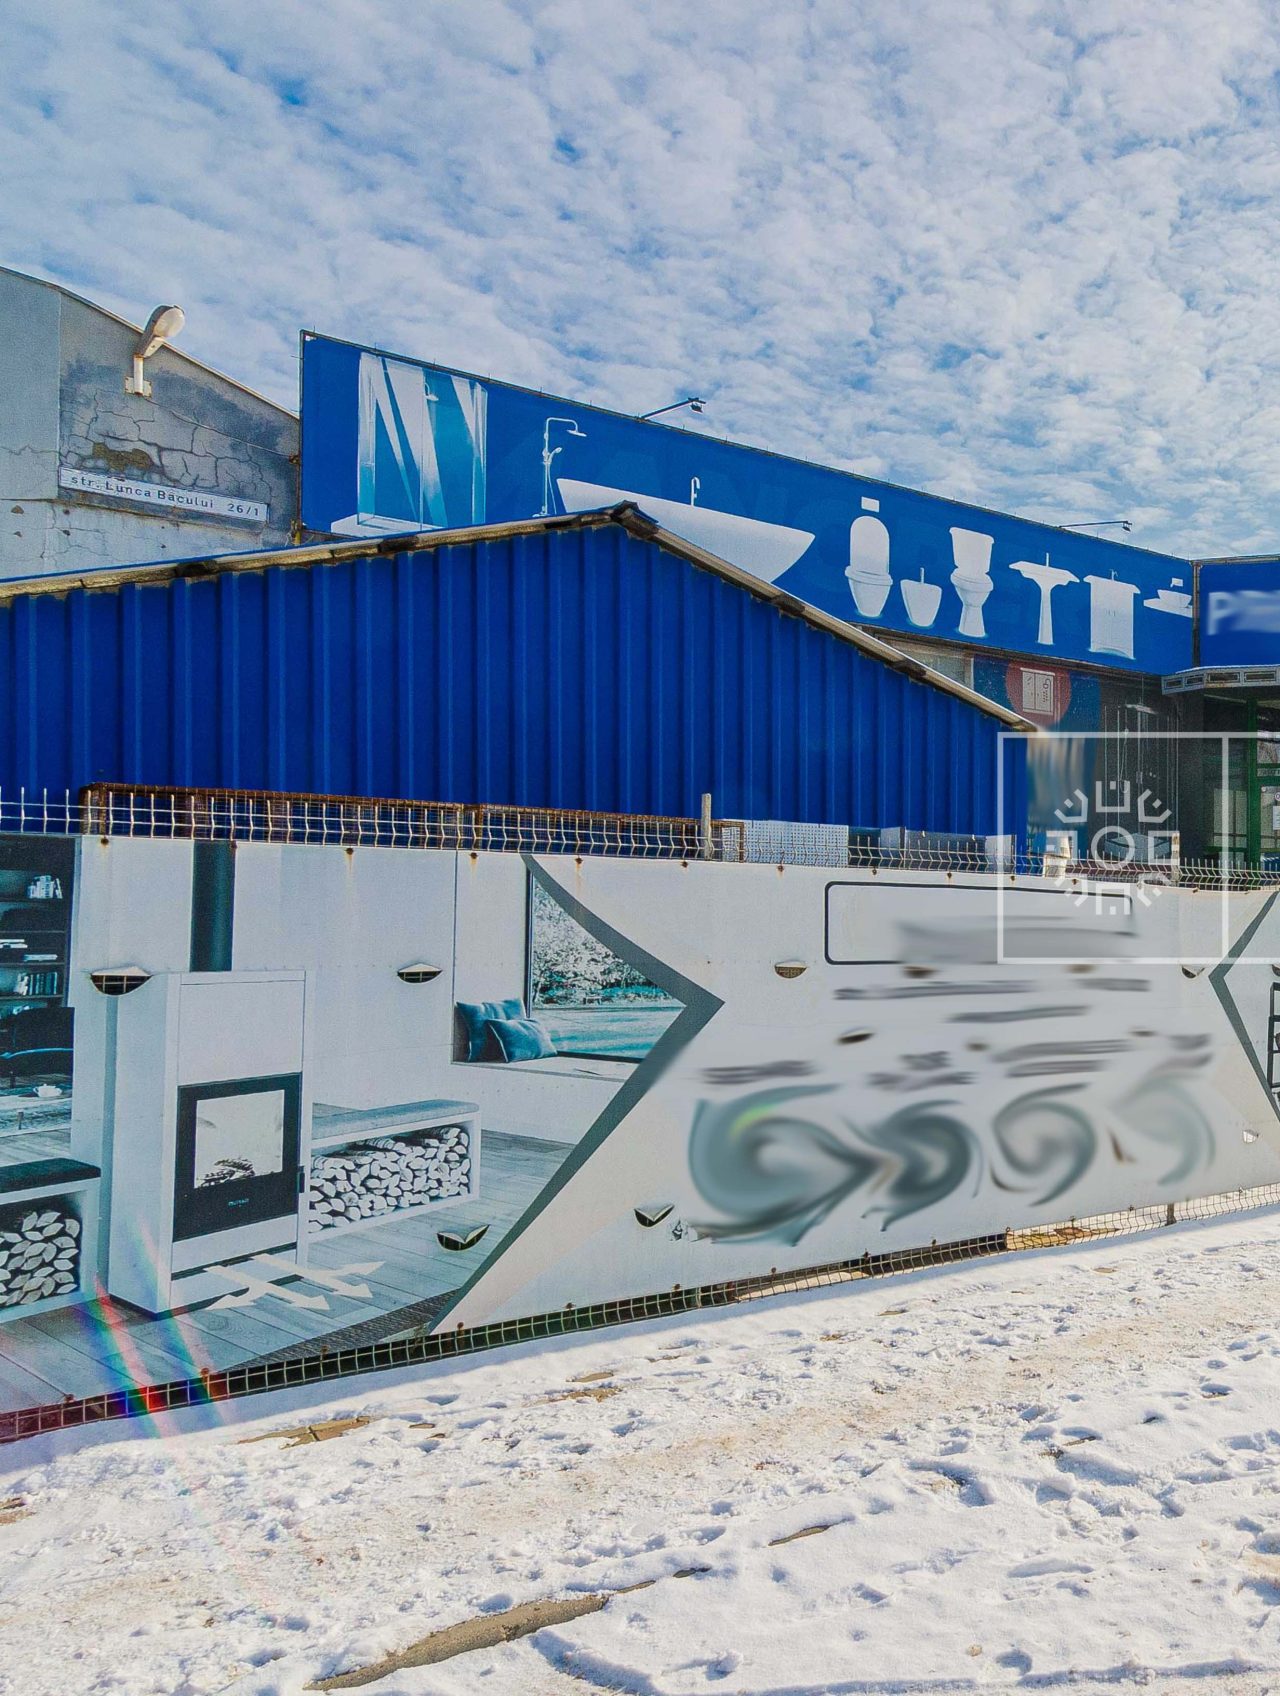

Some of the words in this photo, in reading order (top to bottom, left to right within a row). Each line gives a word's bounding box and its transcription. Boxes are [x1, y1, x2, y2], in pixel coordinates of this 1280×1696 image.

[71, 476, 100, 488] str.
[105, 480, 151, 497] Lunca
[228, 503, 259, 516] 26/1
